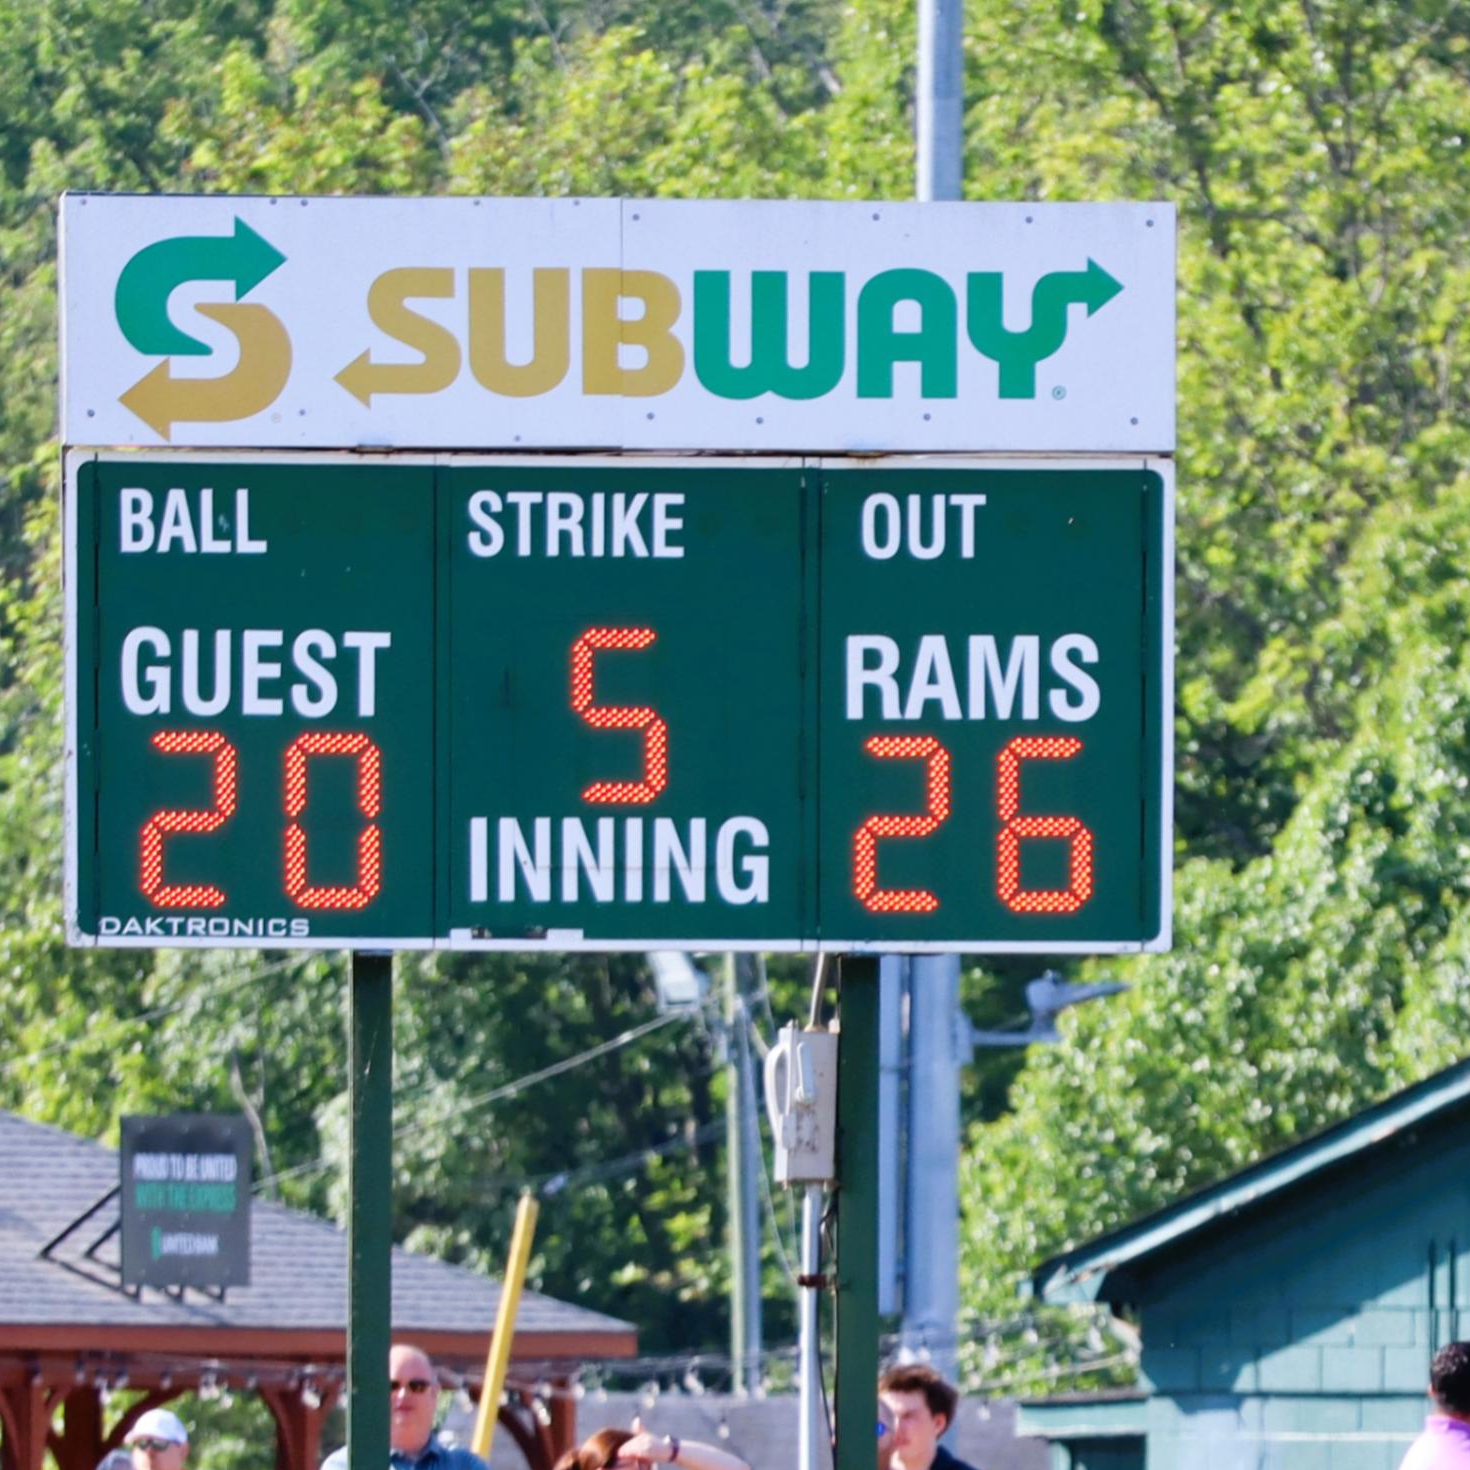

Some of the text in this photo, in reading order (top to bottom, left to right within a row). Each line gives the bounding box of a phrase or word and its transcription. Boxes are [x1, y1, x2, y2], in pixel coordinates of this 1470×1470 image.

[334, 256, 1125, 407] SUBWAY
[121, 489, 987, 560] BALL STRIKE OUT
[121, 627, 1101, 722] GUEST RAMS
[571, 628, 669, 804] 5
[140, 732, 382, 910] 20
[469, 816, 770, 905] INNING
[853, 736, 1094, 914] 26
[99, 916, 310, 937] DAKTRONICS
